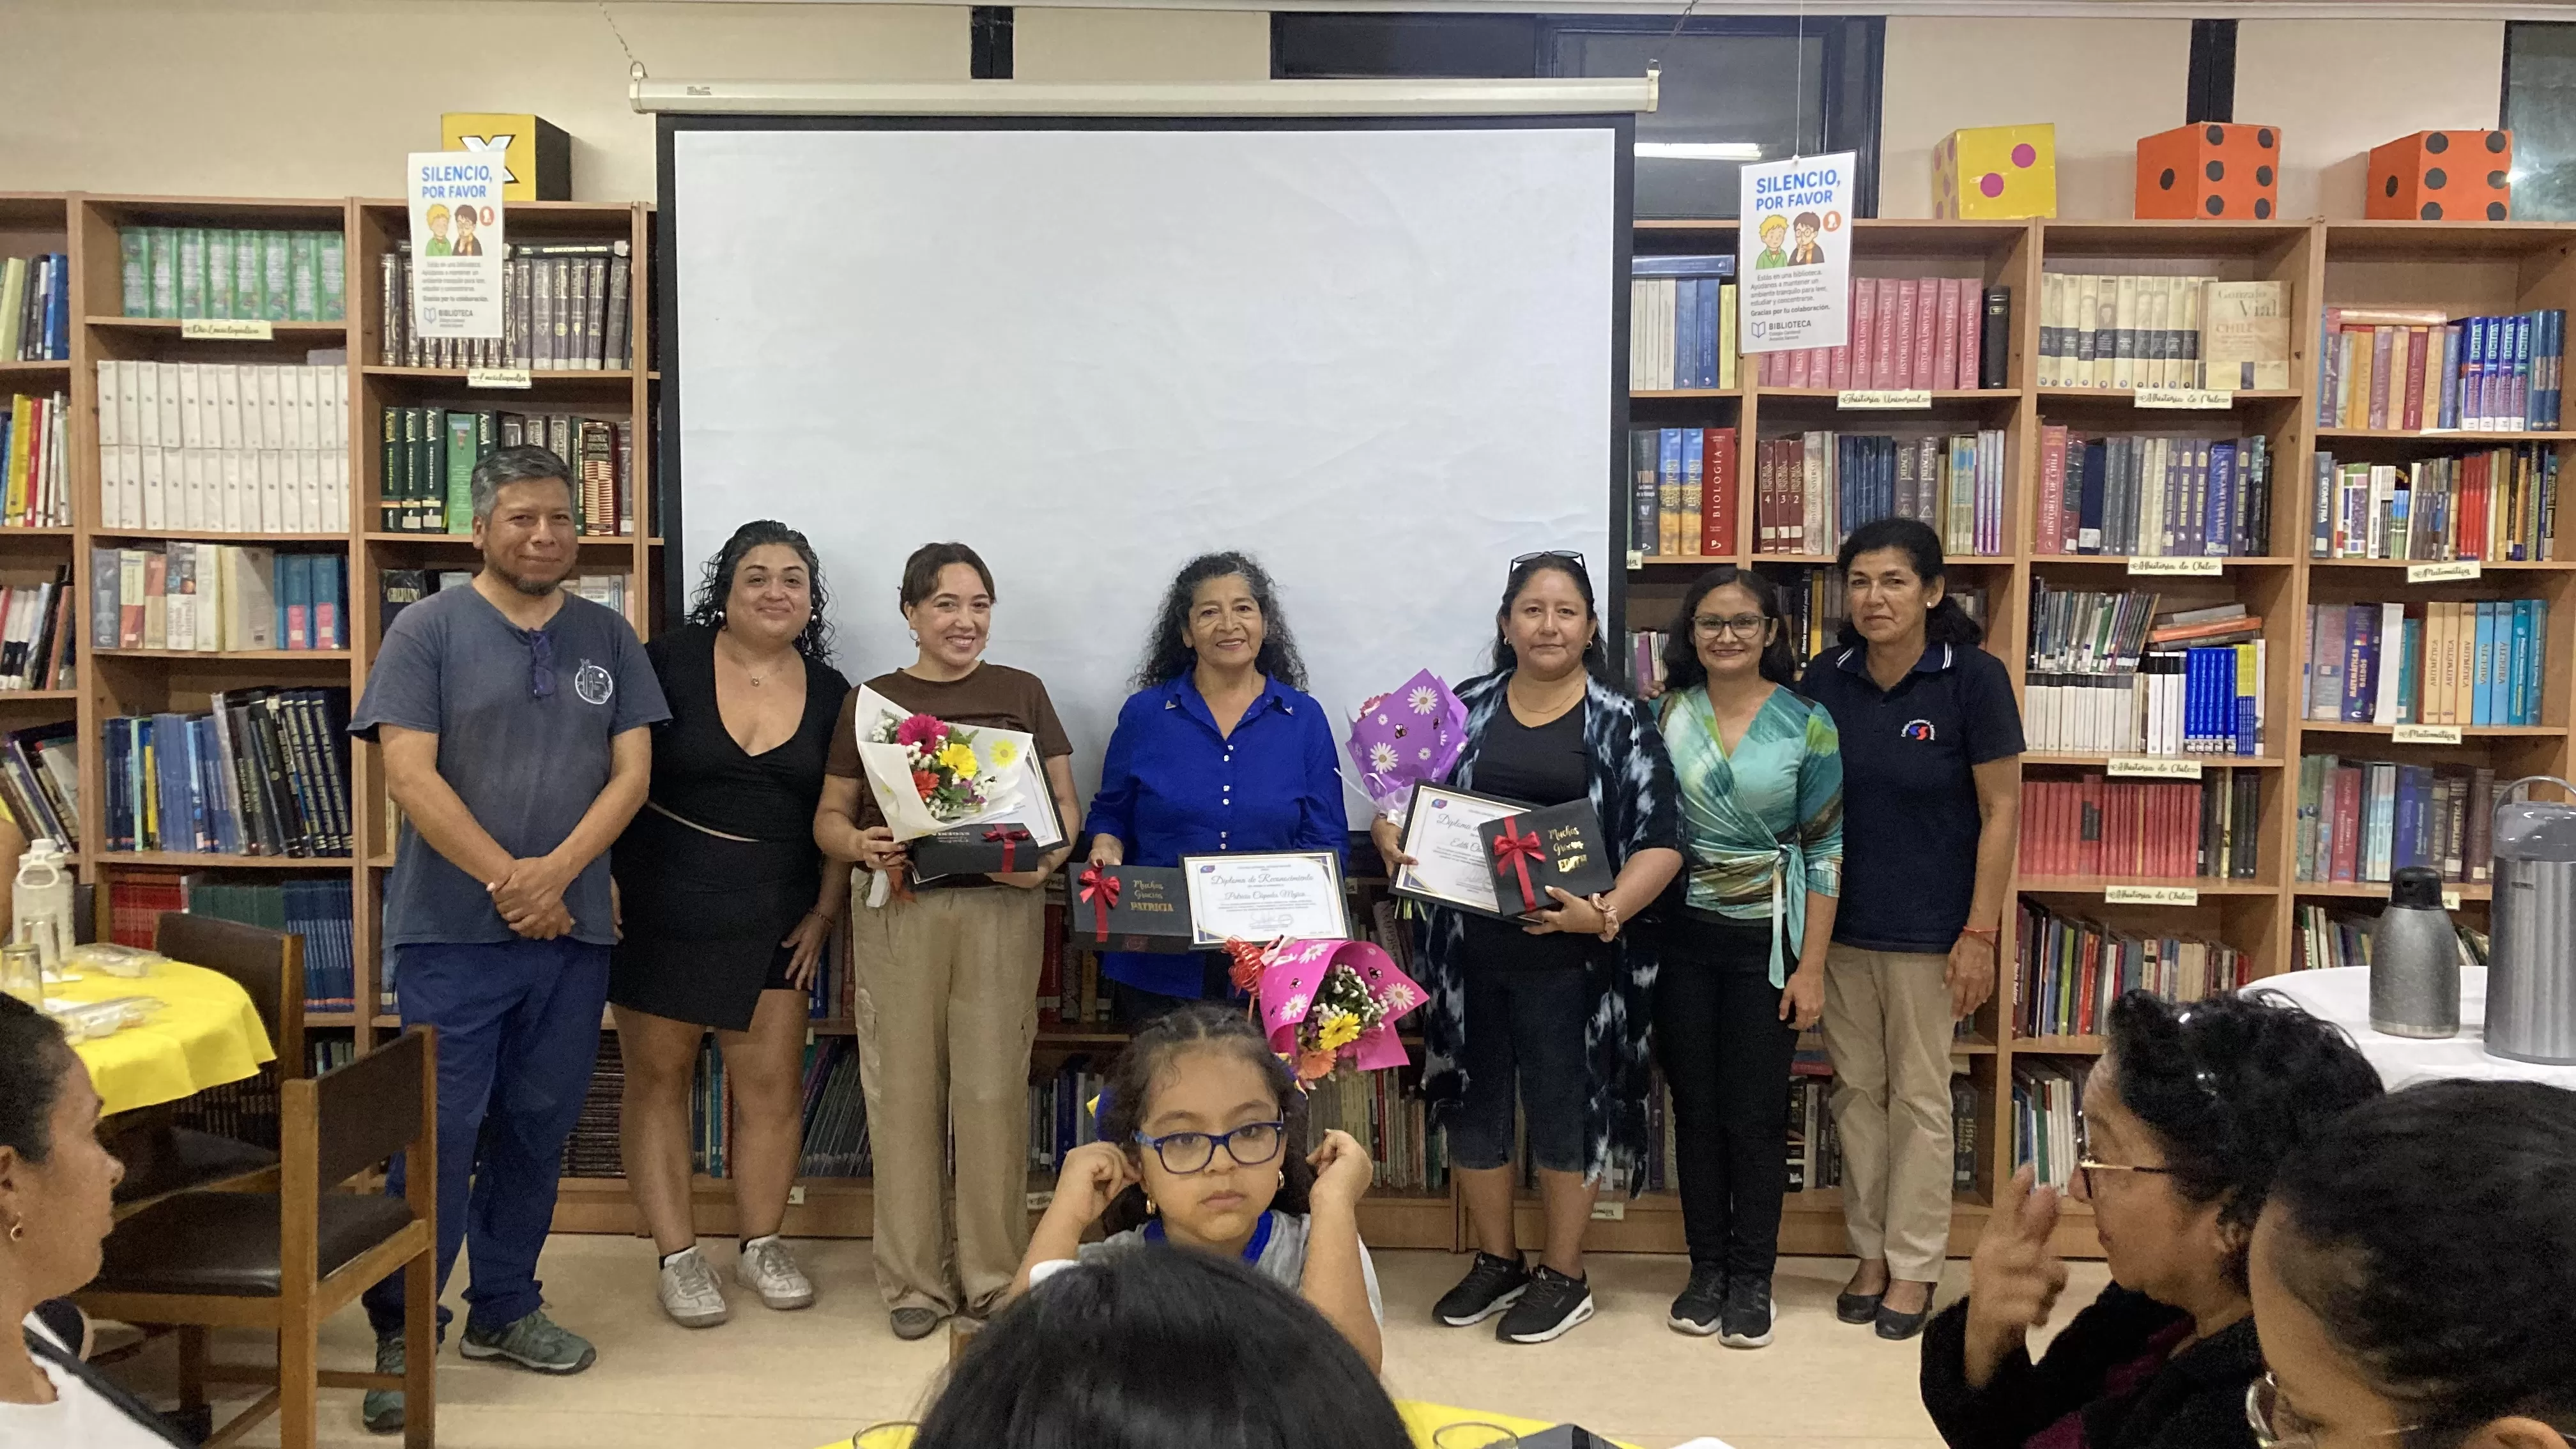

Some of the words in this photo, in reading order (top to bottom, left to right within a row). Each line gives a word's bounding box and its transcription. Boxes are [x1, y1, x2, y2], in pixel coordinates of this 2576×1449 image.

[422, 165, 492, 183] SILENCIO,
[1756, 169, 1841, 194] SILENCIO,
[422, 186, 445, 199] POR
[448, 185, 486, 198] FAVOR
[1756, 196, 1783, 211] POR
[1788, 190, 1832, 208] FAVOR
[1791, 304, 1830, 313] colaboración.
[1768, 320, 1812, 330] BIBLIOTECA
[1860, 296, 1869, 339] UNIVERSAL
[1858, 340, 1866, 374] HISTORIA
[1881, 339, 1889, 374] HISTORIA
[1899, 340, 1908, 376] HISTORIA
[1884, 394, 1922, 403] Universal
[2050, 450, 2058, 478] CHILE
[1712, 450, 1722, 518] BIOLOGÍA
[2048, 480, 2057, 492] DE
[1765, 495, 1770, 503] 4
[1780, 495, 1786, 503] 3
[1793, 495, 1799, 503] 2
[2046, 494, 2057, 535] HISTORIA
[2193, 561, 2214, 571] Chile
[2349, 648, 2359, 698] MATEMÁTICAS
[1437, 813, 1471, 832] Diploma
[1548, 825, 1580, 841] Muchas
[1133, 879, 1164, 890] Muchas
[1211, 875, 1246, 887] Diploma
[1258, 873, 1314, 884] Reconocimiento
[1134, 889, 1163, 900] Gracias
[1130, 901, 1174, 912] PATRICIA
